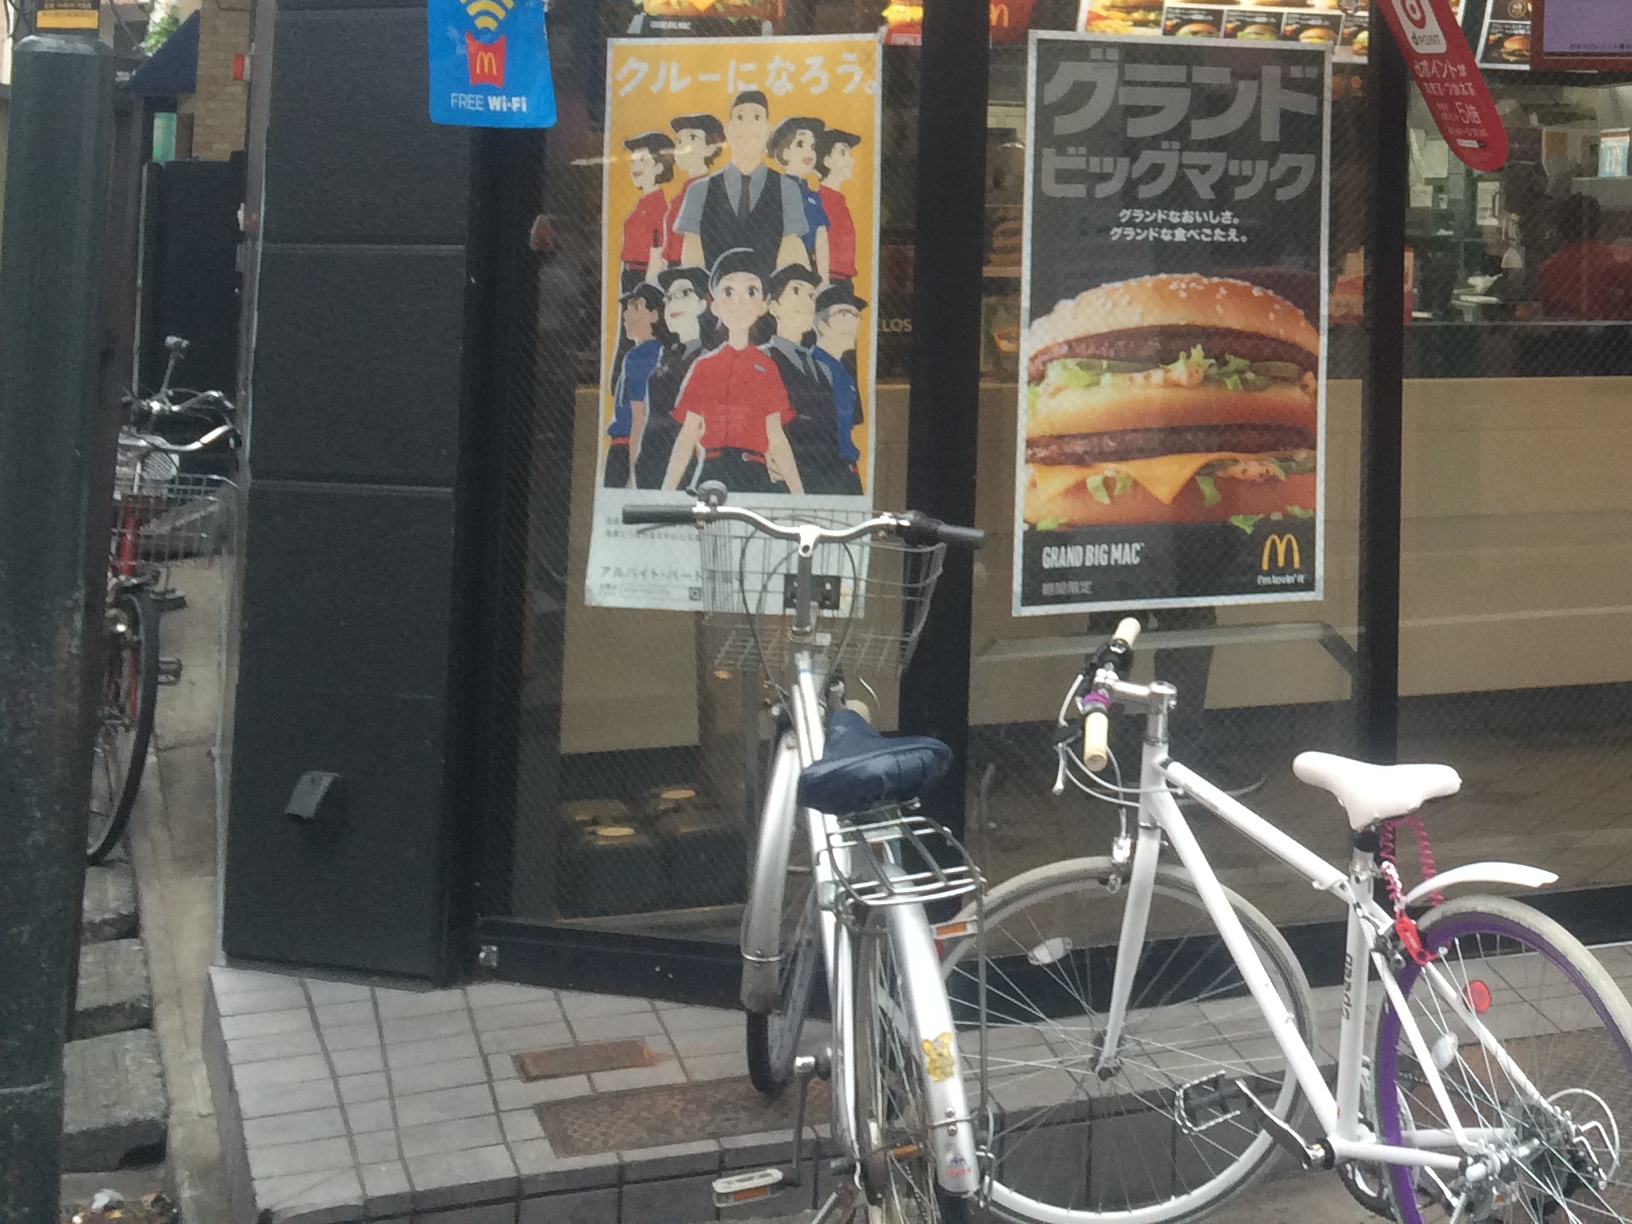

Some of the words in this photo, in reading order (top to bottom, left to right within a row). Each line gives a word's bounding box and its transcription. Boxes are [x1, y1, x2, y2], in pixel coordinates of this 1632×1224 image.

[616, 54, 878, 97] クルーになろう。
[450, 93, 485, 112] FREE
[487, 94, 528, 113] Wi-Fi
[1043, 47, 1319, 143] グランド
[1041, 140, 1317, 202] ビッグマック
[1118, 208, 1241, 226] グランドなおいしさ。
[1042, 544, 1084, 569] GRAND
[1085, 543, 1109, 567] BIG
